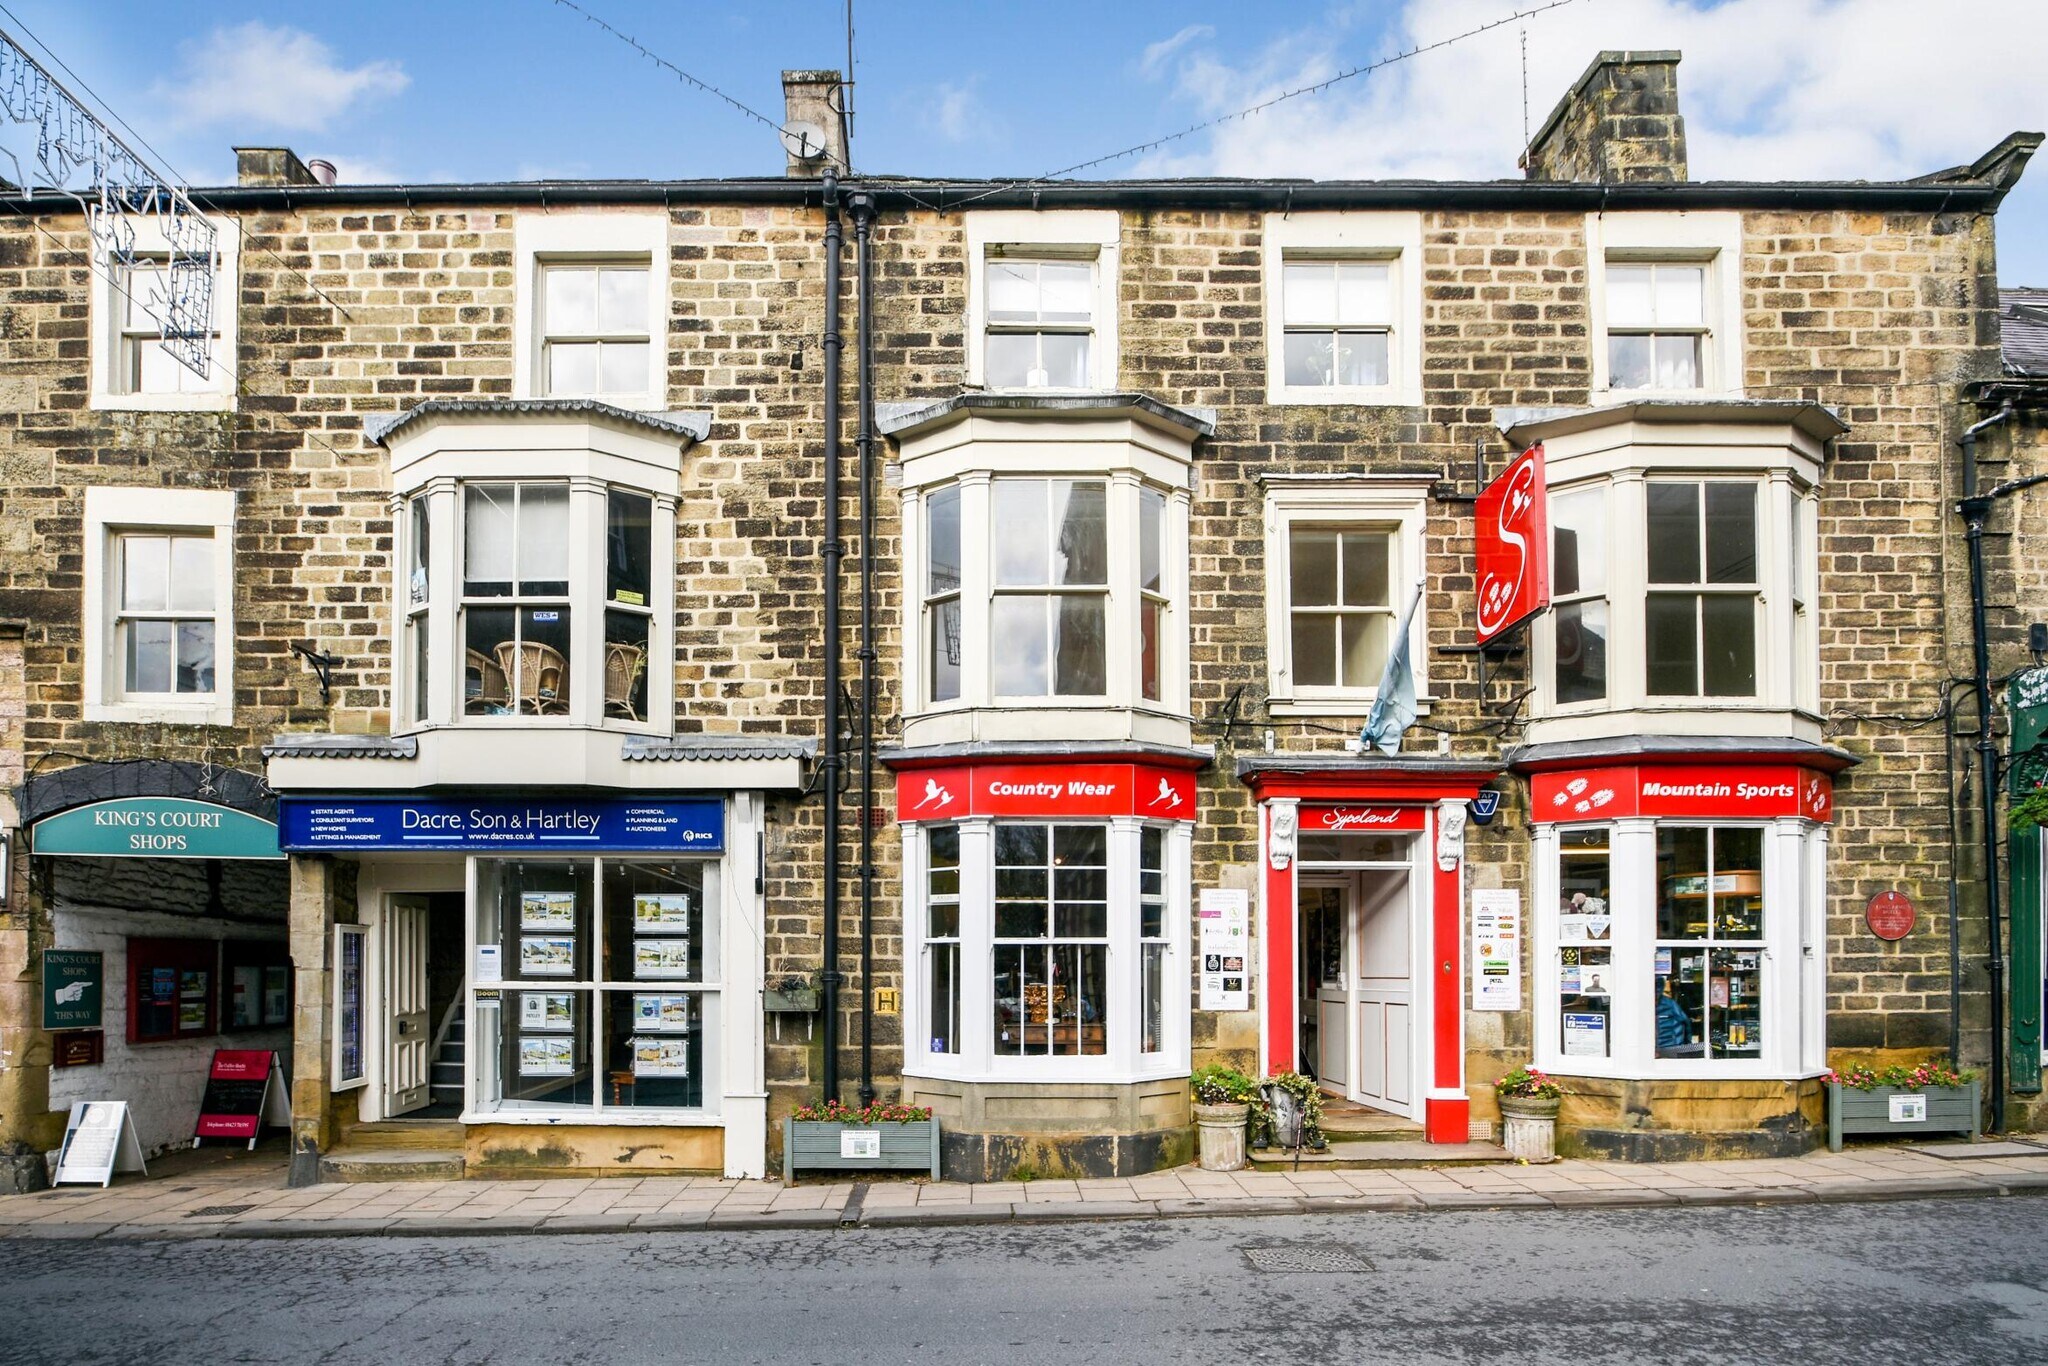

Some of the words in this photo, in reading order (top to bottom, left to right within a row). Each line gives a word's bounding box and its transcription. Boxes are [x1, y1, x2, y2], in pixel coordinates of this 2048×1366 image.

[989, 781, 1063, 799] Country
[1068, 781, 1115, 796] Wear
[1642, 782, 1731, 796] Mountain
[1736, 783, 1794, 799] Sports
[94, 810, 156, 827] KING'S
[160, 811, 223, 828] COURT
[403, 809, 466, 830] Dacre,
[470, 809, 506, 829] Son
[510, 815, 522, 829] &
[526, 809, 600, 835] Hartley
[1322, 806, 1400, 830] Sypeland
[130, 834, 187, 850] SHOPS
[47, 954, 75, 964] KING'S
[76, 955, 101, 964] COURT
[62, 967, 87, 976] SHOPS
[878, 991, 895, 1011] H
[55, 1011, 74, 1020] THIS
[75, 1011, 91, 1019] WAY
